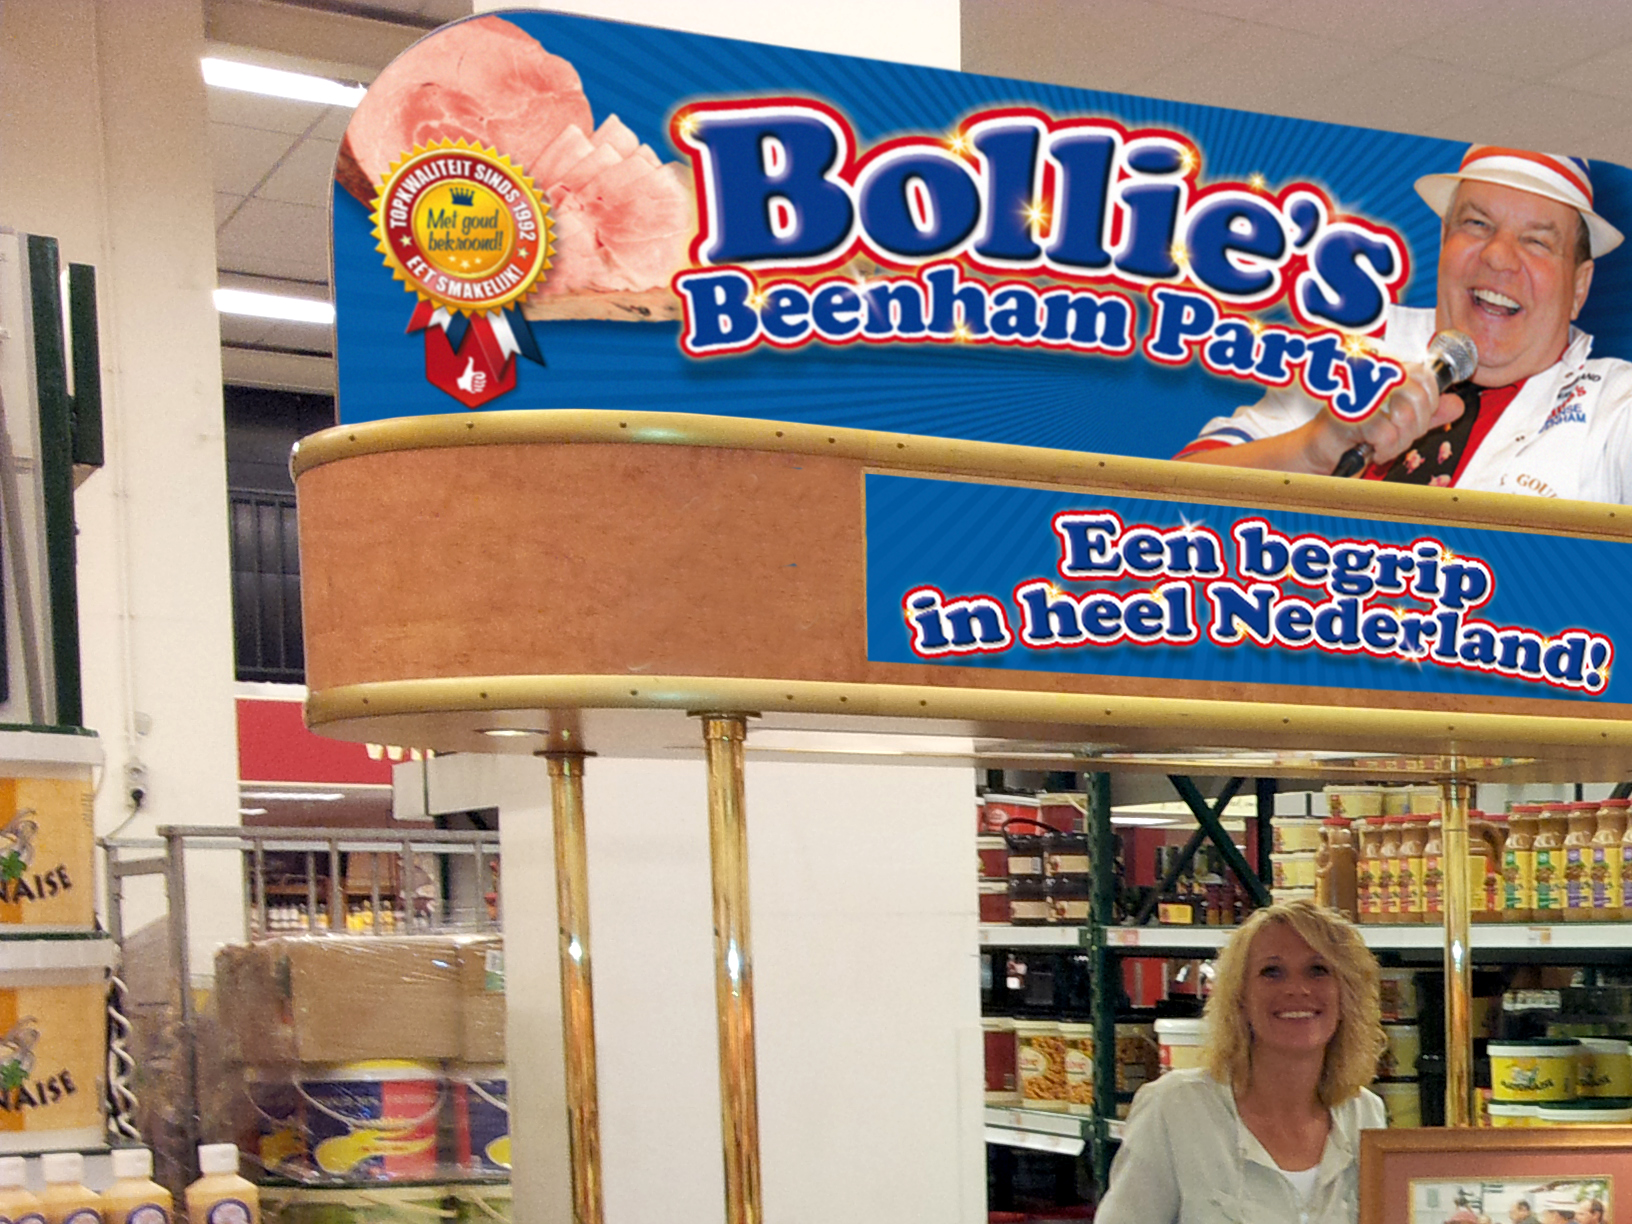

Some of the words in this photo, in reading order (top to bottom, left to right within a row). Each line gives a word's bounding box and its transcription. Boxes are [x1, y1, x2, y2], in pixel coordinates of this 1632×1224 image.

[390, 158, 474, 229] TOPKWALITEIT
[474, 164, 520, 203] SINDS
[513, 201, 537, 241] 1992
[427, 208, 458, 229] Met
[462, 208, 499, 236] goud
[684, 104, 1403, 335] Bollie's
[406, 255, 437, 284] EET
[436, 263, 525, 299] SMAKELIJK!
[678, 265, 1133, 354] Beenham
[1150, 287, 1402, 418] Party
[1059, 515, 1220, 578] Een
[1237, 518, 1491, 607] begrip
[909, 589, 1006, 654] in
[1020, 582, 1192, 646] heel
[1213, 584, 1610, 690] Nederland!
